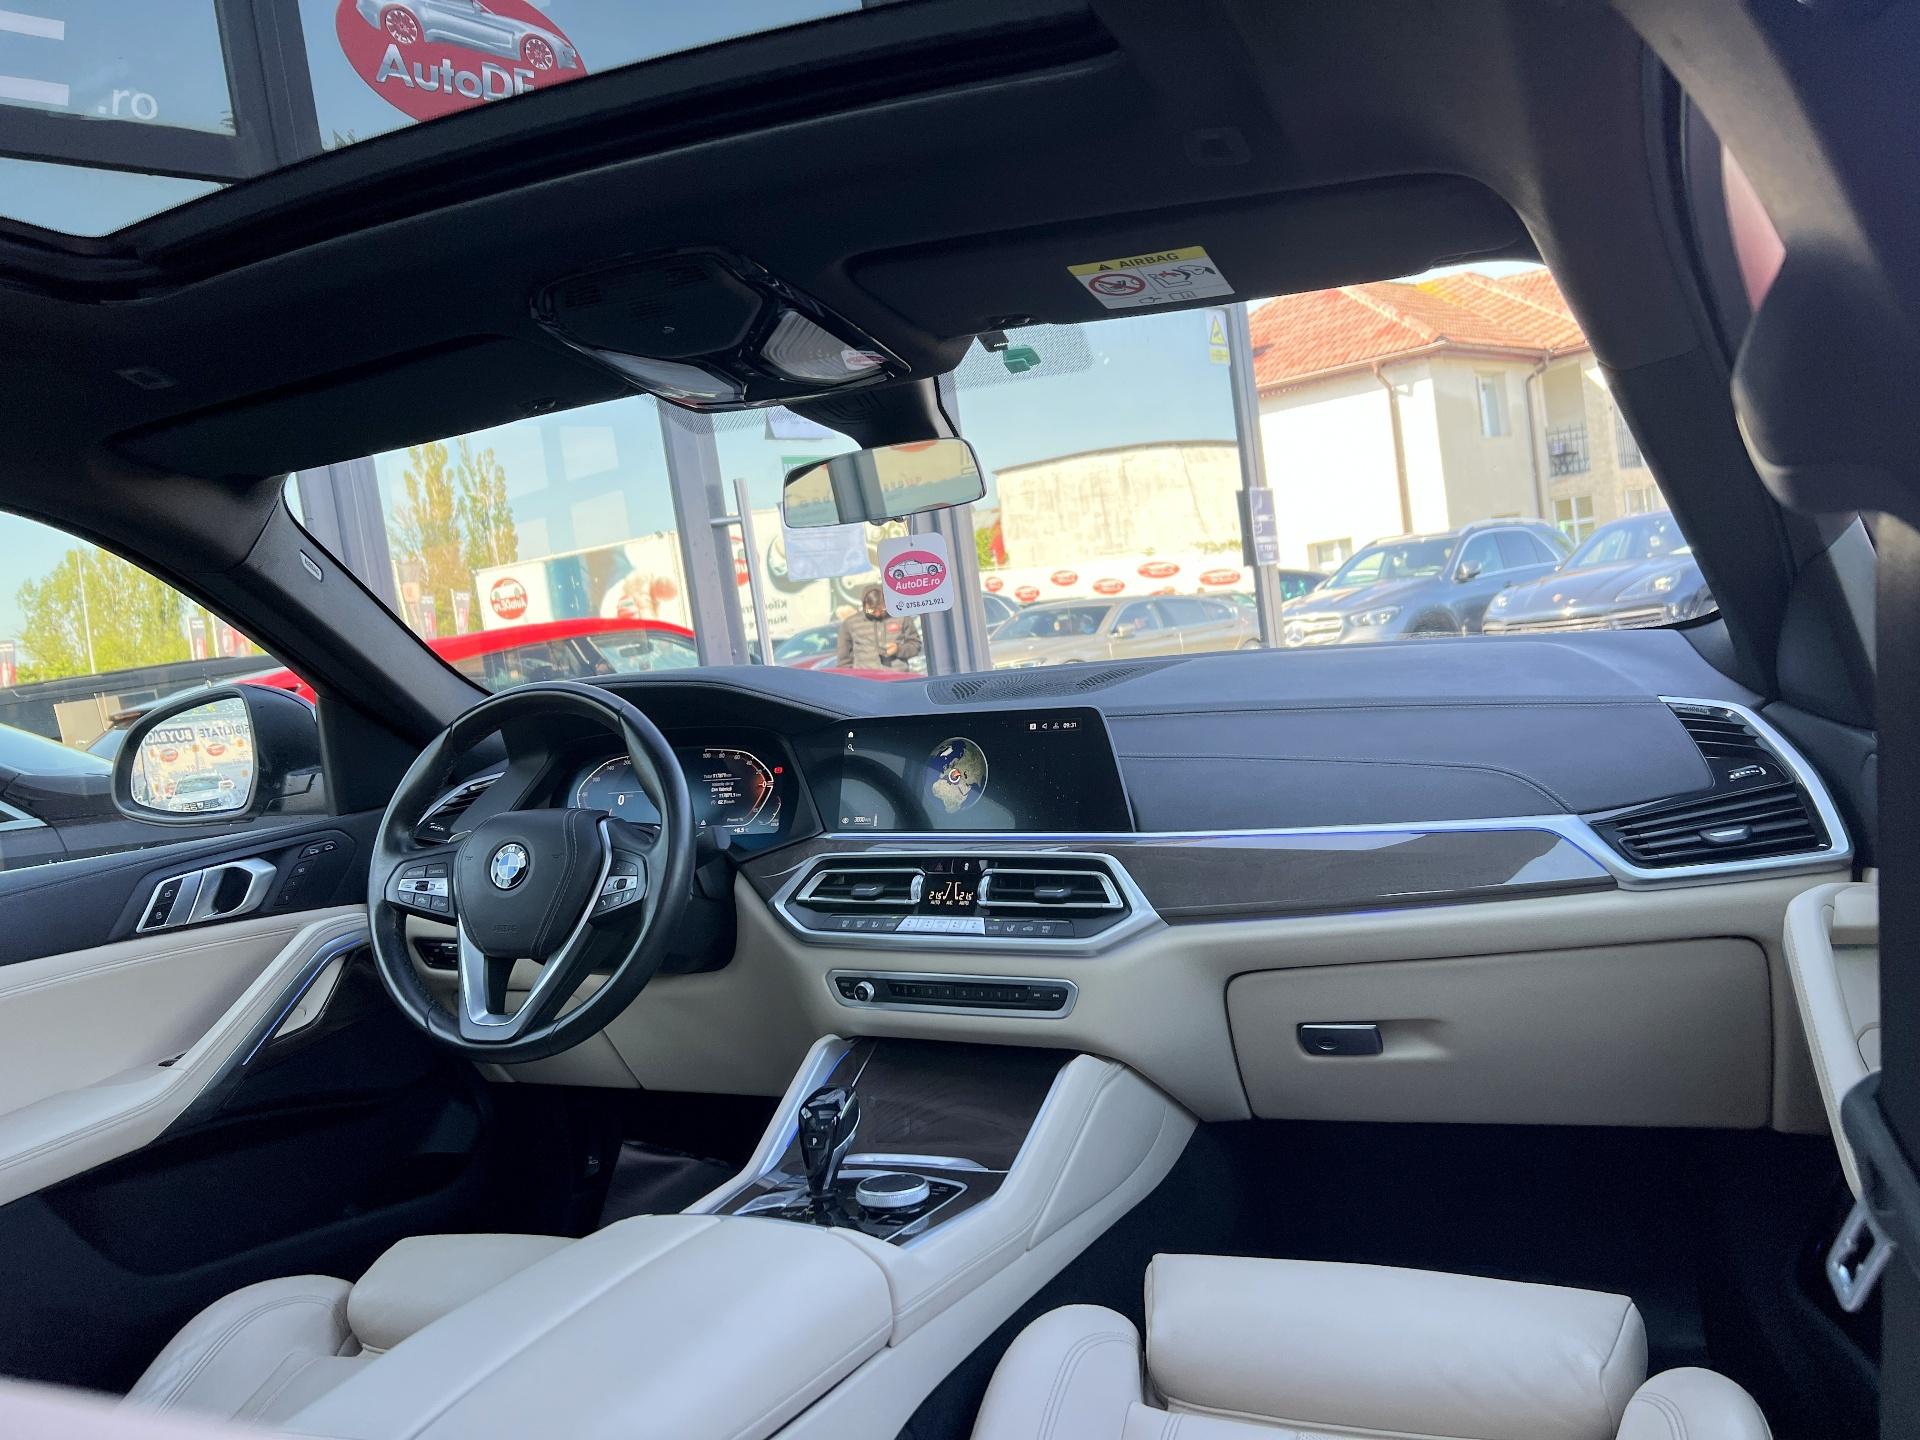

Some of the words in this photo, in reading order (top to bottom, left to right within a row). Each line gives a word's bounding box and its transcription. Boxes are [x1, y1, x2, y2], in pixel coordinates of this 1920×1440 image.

[97, 88, 158, 120] .ro
[1119, 252, 1180, 269] AIRBAG
[895, 578, 941, 591] AutoDE.ro
[617, 794, 625, 806] 0
